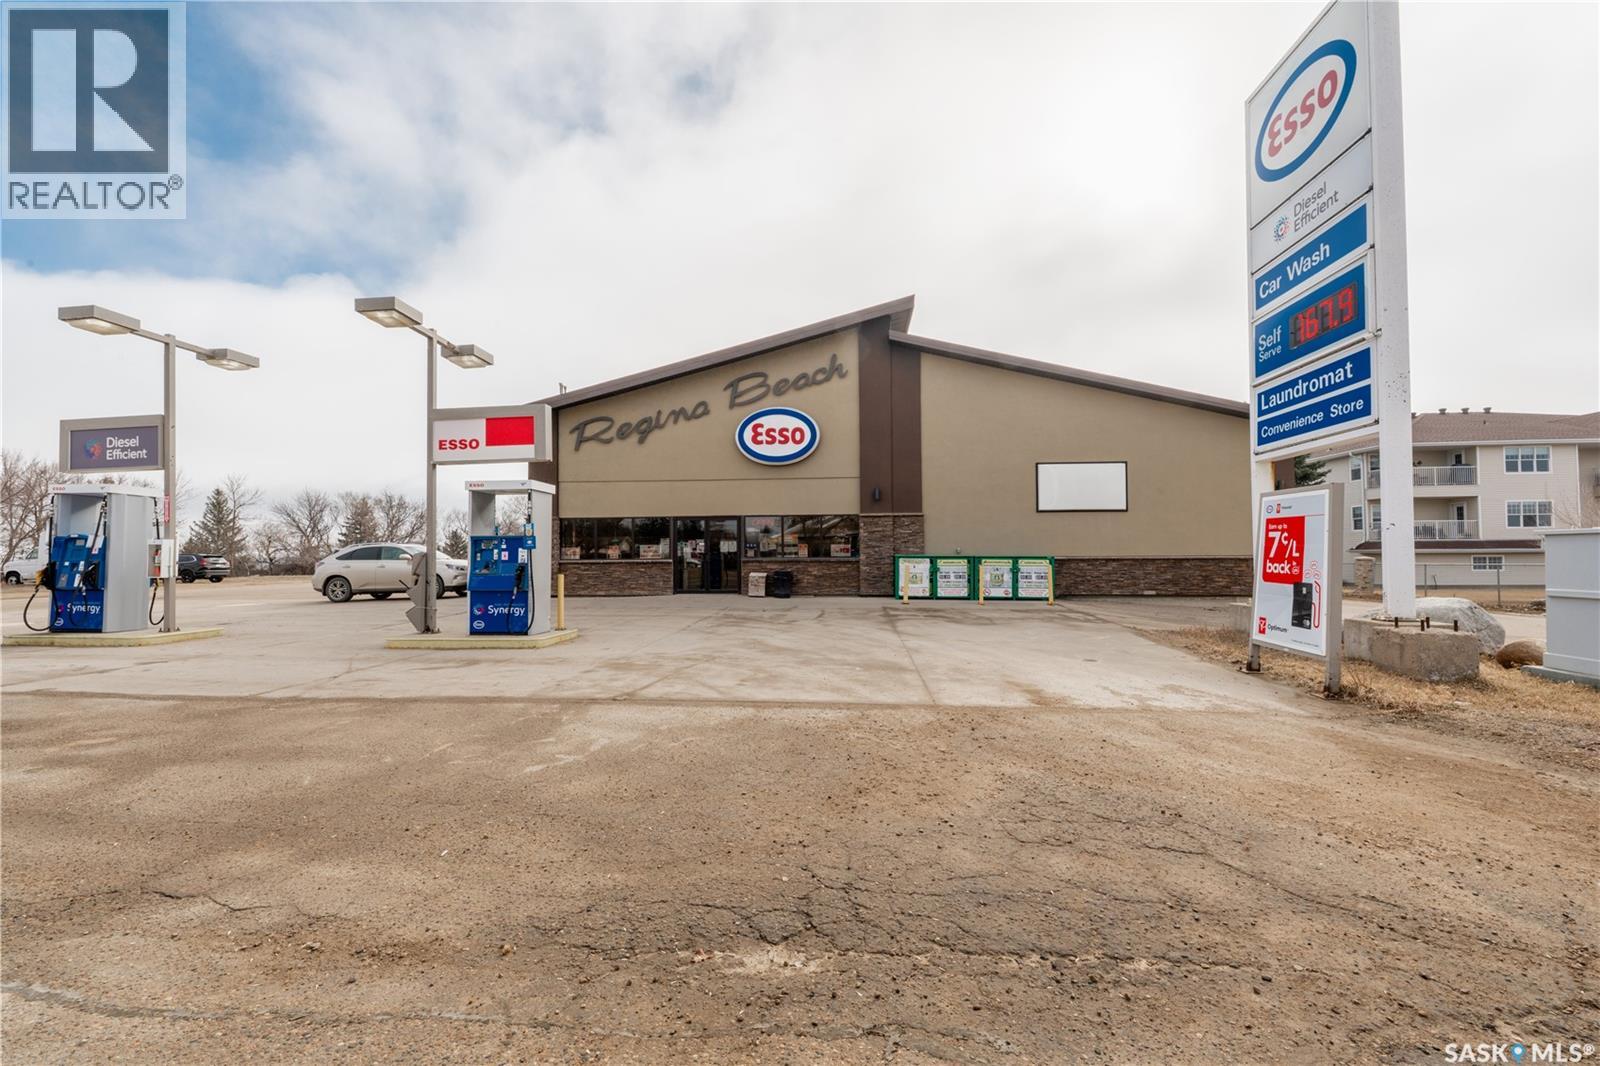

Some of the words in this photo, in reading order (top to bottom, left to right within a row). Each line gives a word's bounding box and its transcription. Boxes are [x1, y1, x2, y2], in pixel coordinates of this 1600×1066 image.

[1293, 181, 1327, 218] Diesel
[1294, 190, 1339, 233] Efficient
[1259, 276, 1282, 298] Car
[1286, 242, 1331, 281] Wash
[1296, 288, 1353, 344] 167.9
[1258, 325, 1282, 351] Self
[1258, 344, 1282, 362] Serve
[1260, 361, 1354, 411] Laundromat
[569, 400, 711, 451] Regina
[723, 353, 848, 410] Beach
[1260, 410, 1324, 438] Convenience
[1329, 398, 1364, 418] Store
[106, 436, 140, 448] Diesel
[106, 448, 148, 461] Efficient
[438, 438, 480, 451] ESSO
[1266, 559, 1291, 575] back
[487, 604, 526, 617] Synergy
